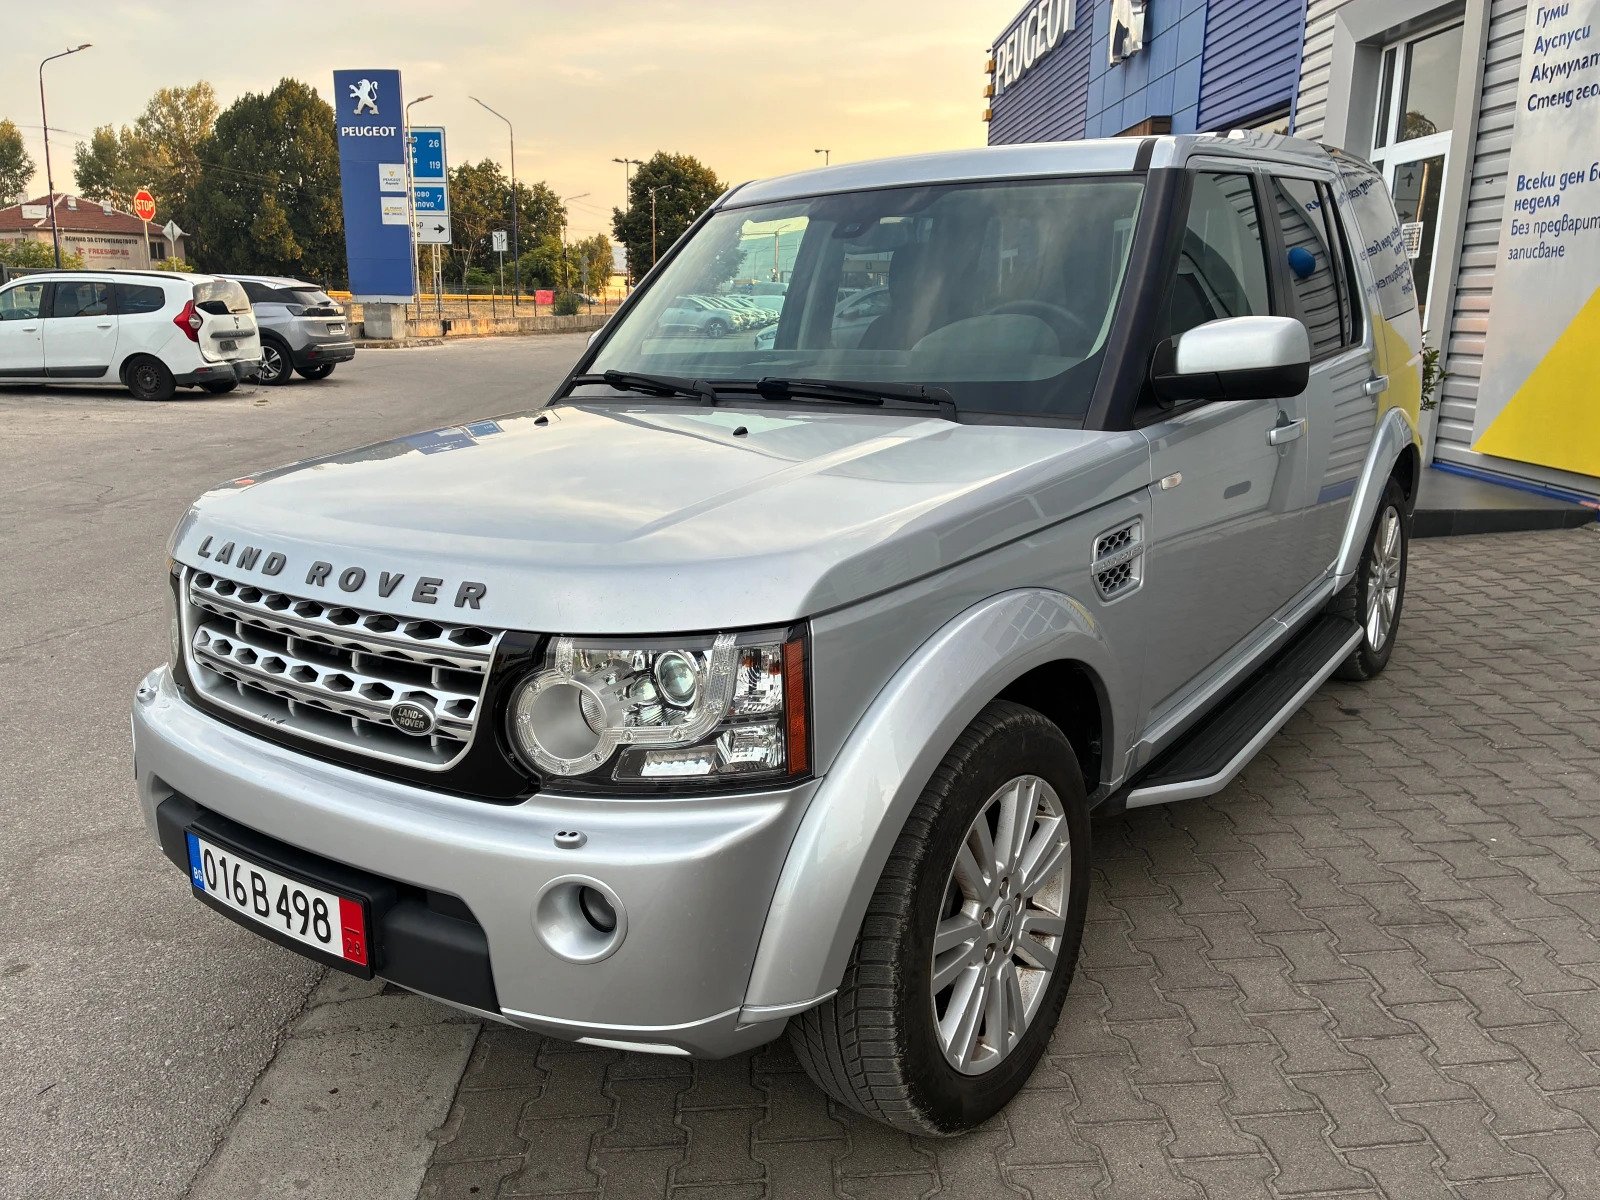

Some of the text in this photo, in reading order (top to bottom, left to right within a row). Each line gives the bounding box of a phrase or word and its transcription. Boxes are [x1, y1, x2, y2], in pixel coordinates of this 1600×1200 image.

[1536, 3, 1569, 28] Гуми
[1533, 25, 1591, 56] Ауспуси
[1527, 89, 1573, 111] Стенд
[341, 126, 397, 137] PEUGEOT
[429, 139, 440, 148] 26
[429, 161, 441, 169] 119
[1516, 162, 1600, 192] Всеки ден б
[136, 200, 153, 211] STOP
[436, 194, 442, 202] 7
[1514, 194, 1560, 214] неделя
[1511, 219, 1530, 236] Без
[1508, 241, 1565, 260] записване
[197, 535, 487, 609] LAND ROVER
[398, 708, 418, 719] LAND
[400, 717, 425, 729] ROVER
[193, 866, 203, 882] BG
[203, 848, 331, 944] 016B498
